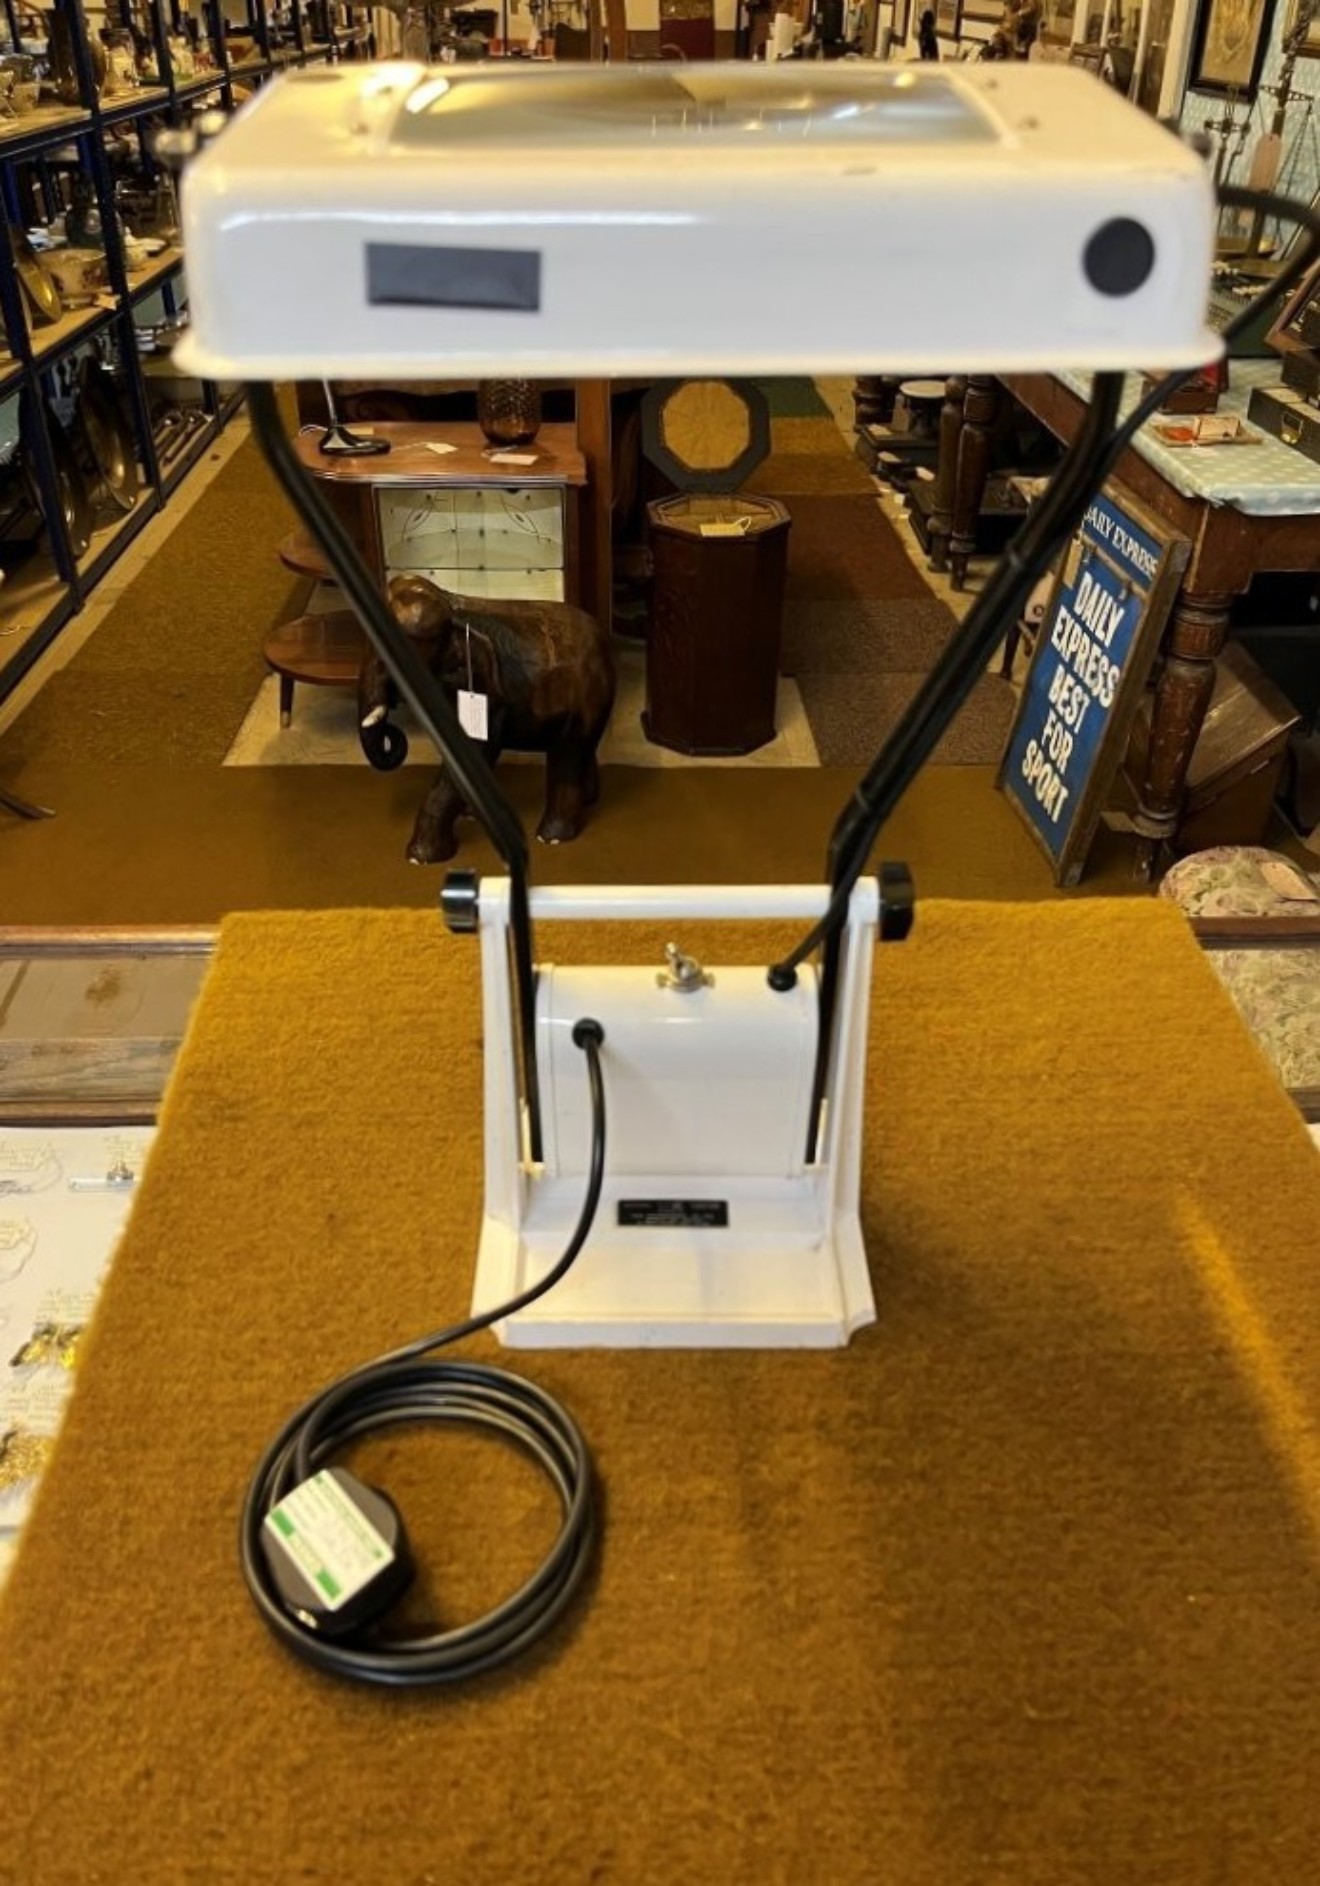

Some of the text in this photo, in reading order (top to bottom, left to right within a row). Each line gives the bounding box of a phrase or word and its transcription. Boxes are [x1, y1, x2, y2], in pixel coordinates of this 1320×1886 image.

[1074, 571, 1125, 648] DAILY
[1051, 605, 1120, 708] EXPRESS
[1049, 664, 1090, 734] BEST
[1021, 738, 1069, 823] SPORT
[1041, 709, 1073, 775] FOR
